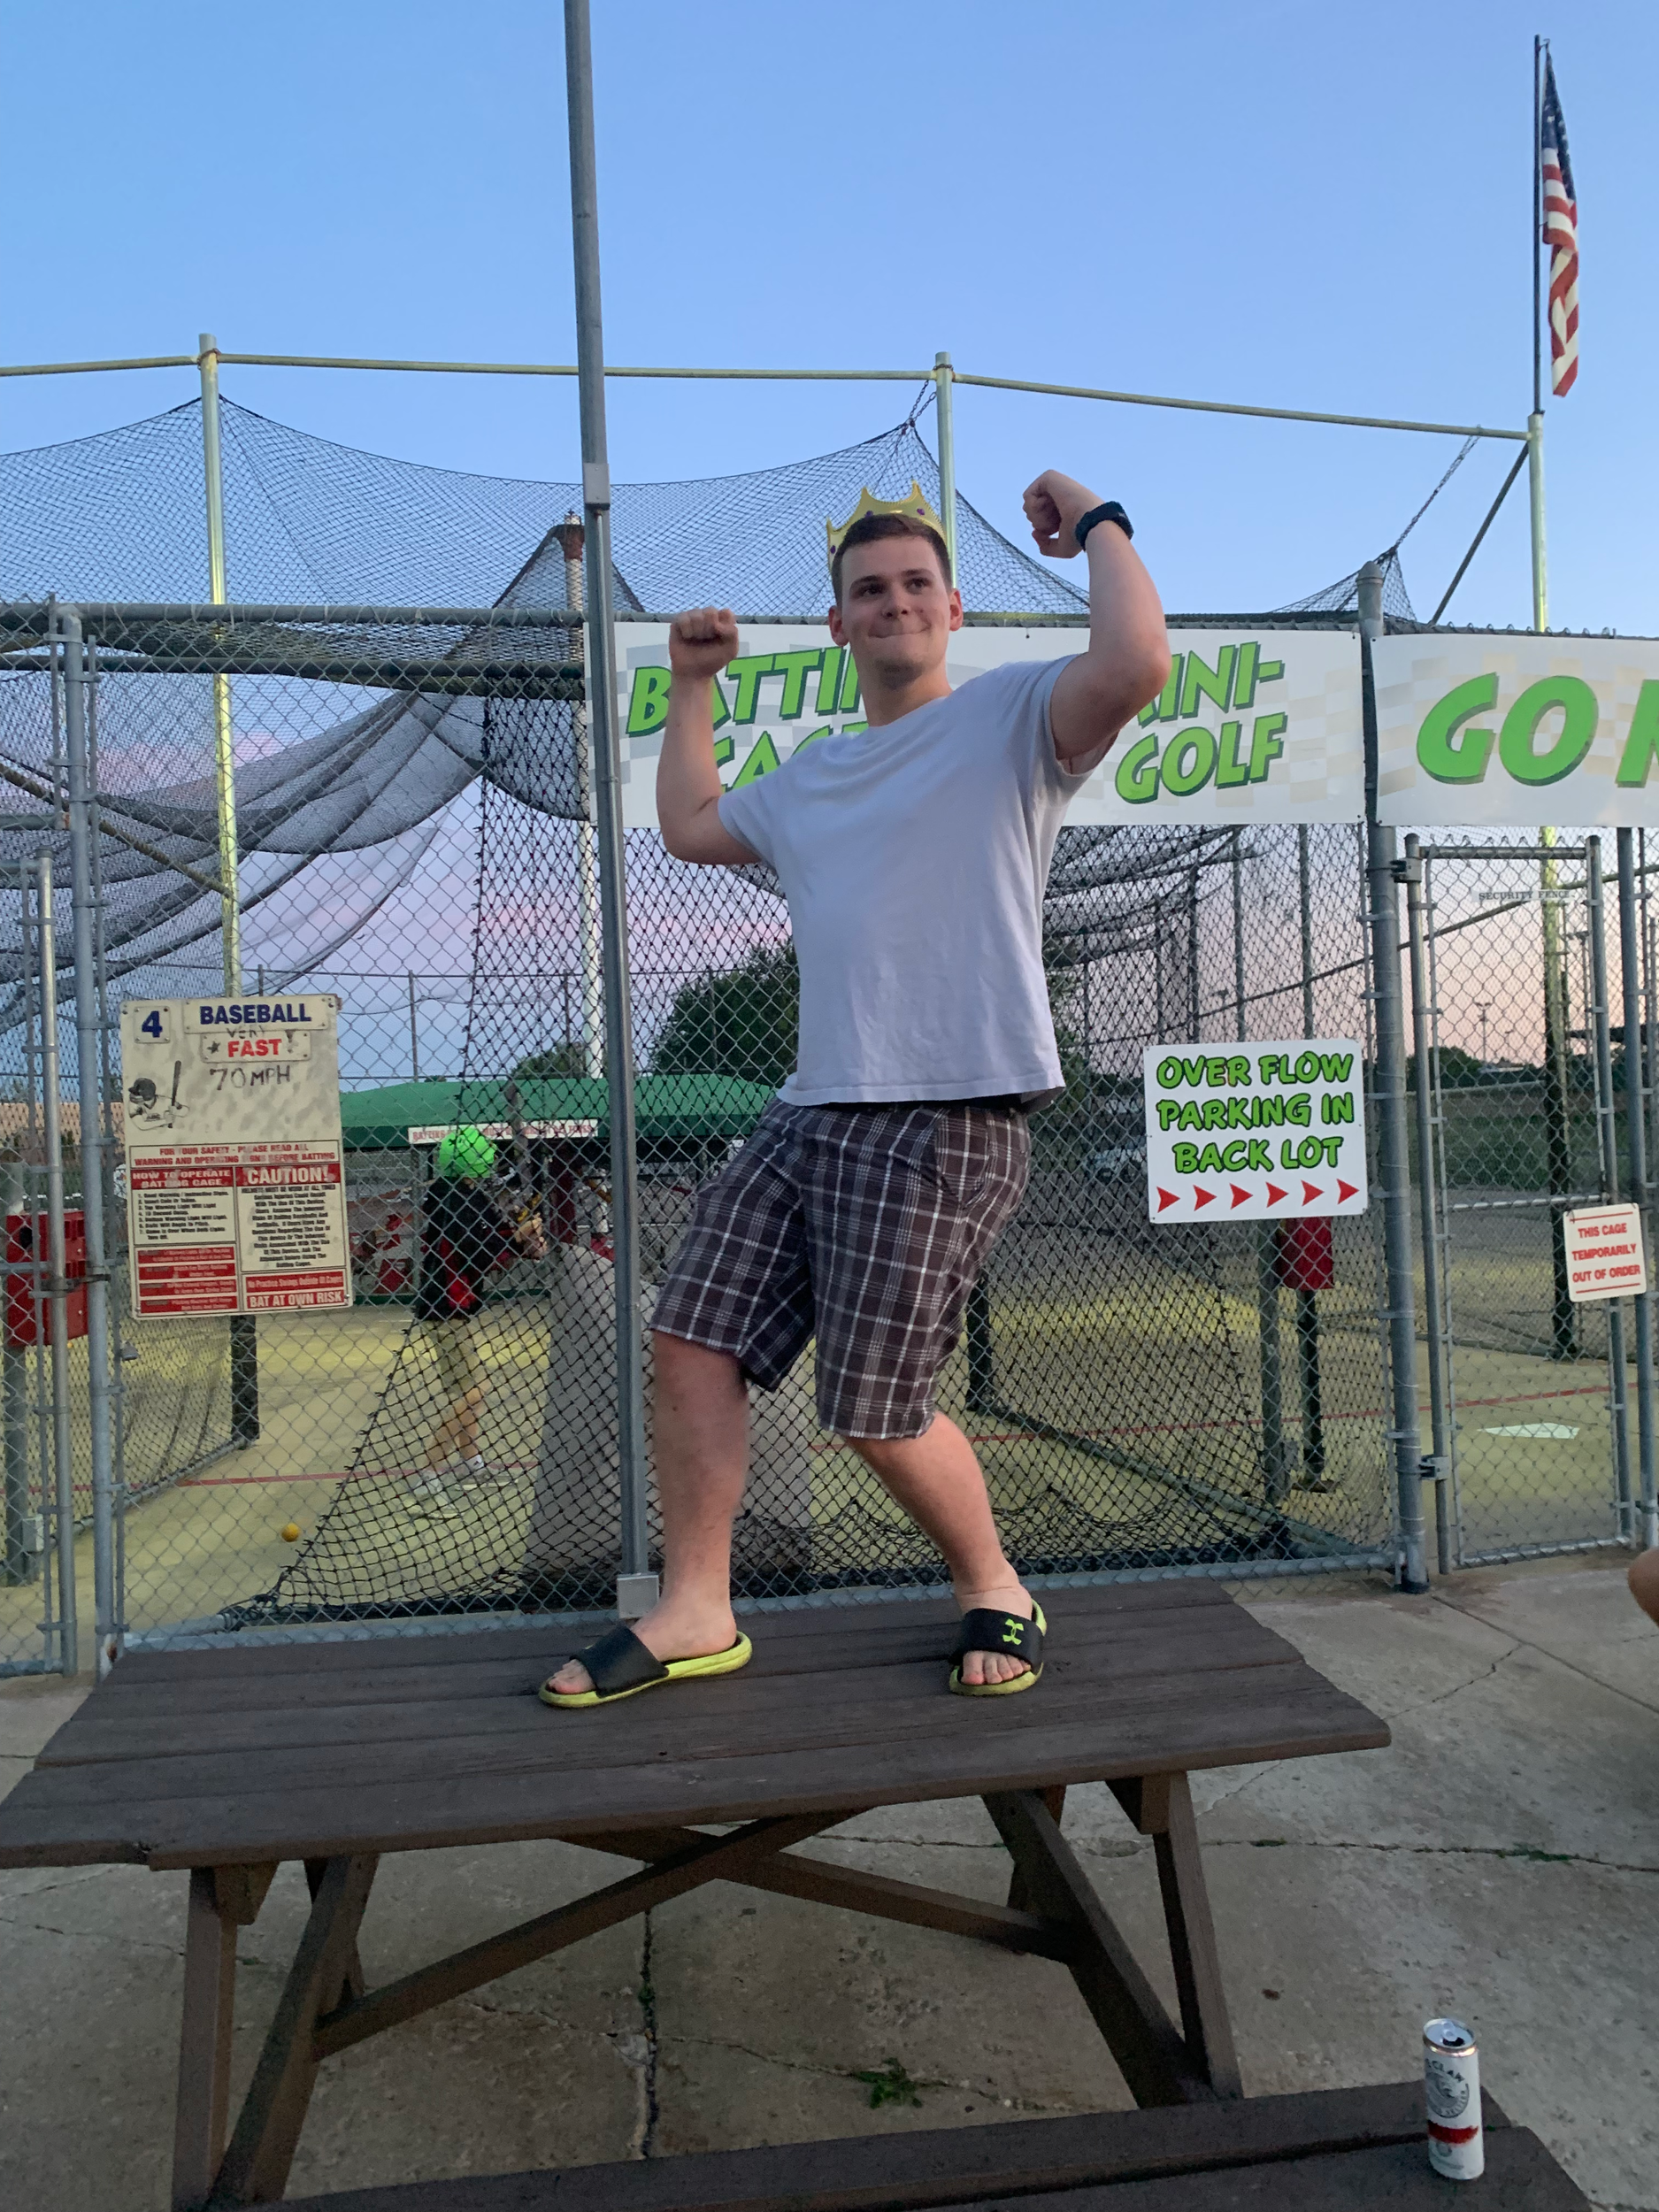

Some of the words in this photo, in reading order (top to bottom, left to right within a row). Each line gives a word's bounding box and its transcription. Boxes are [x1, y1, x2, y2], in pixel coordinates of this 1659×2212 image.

[626, 645, 864, 737] BTTI
[1138, 641, 1285, 729] INI-
[1417, 672, 1599, 787] GO
[1115, 712, 1288, 804] GOLF
[1479, 891, 1533, 900] SECURITY
[142, 1010, 163, 1038] 4
[199, 1003, 311, 1025] BASEBALL
[227, 1039, 282, 1057] FAST
[1156, 1055, 1252, 1089] OVER
[1258, 1050, 1354, 1086] FLOW
[1156, 1093, 1311, 1131] PARKING
[1321, 1092, 1355, 1125] IN
[1171, 1139, 1274, 1174] BACK
[1280, 1135, 1344, 1170] LOT
[248, 1166, 328, 1184] CAUTION!
[1578, 1226, 1600, 1238] THIS
[1601, 1223, 1627, 1235] CAGE
[1571, 1243, 1636, 1261] TEMPORARILY
[1572, 1271, 1592, 1283] OUT
[1594, 1269, 1606, 1280] OF
[1609, 1264, 1640, 1278] ORDER
[250, 1296, 270, 1307] BAT
[273, 1294, 285, 1306] AT
[288, 1294, 314, 1306] OWN
[317, 1291, 342, 1303] RISK
